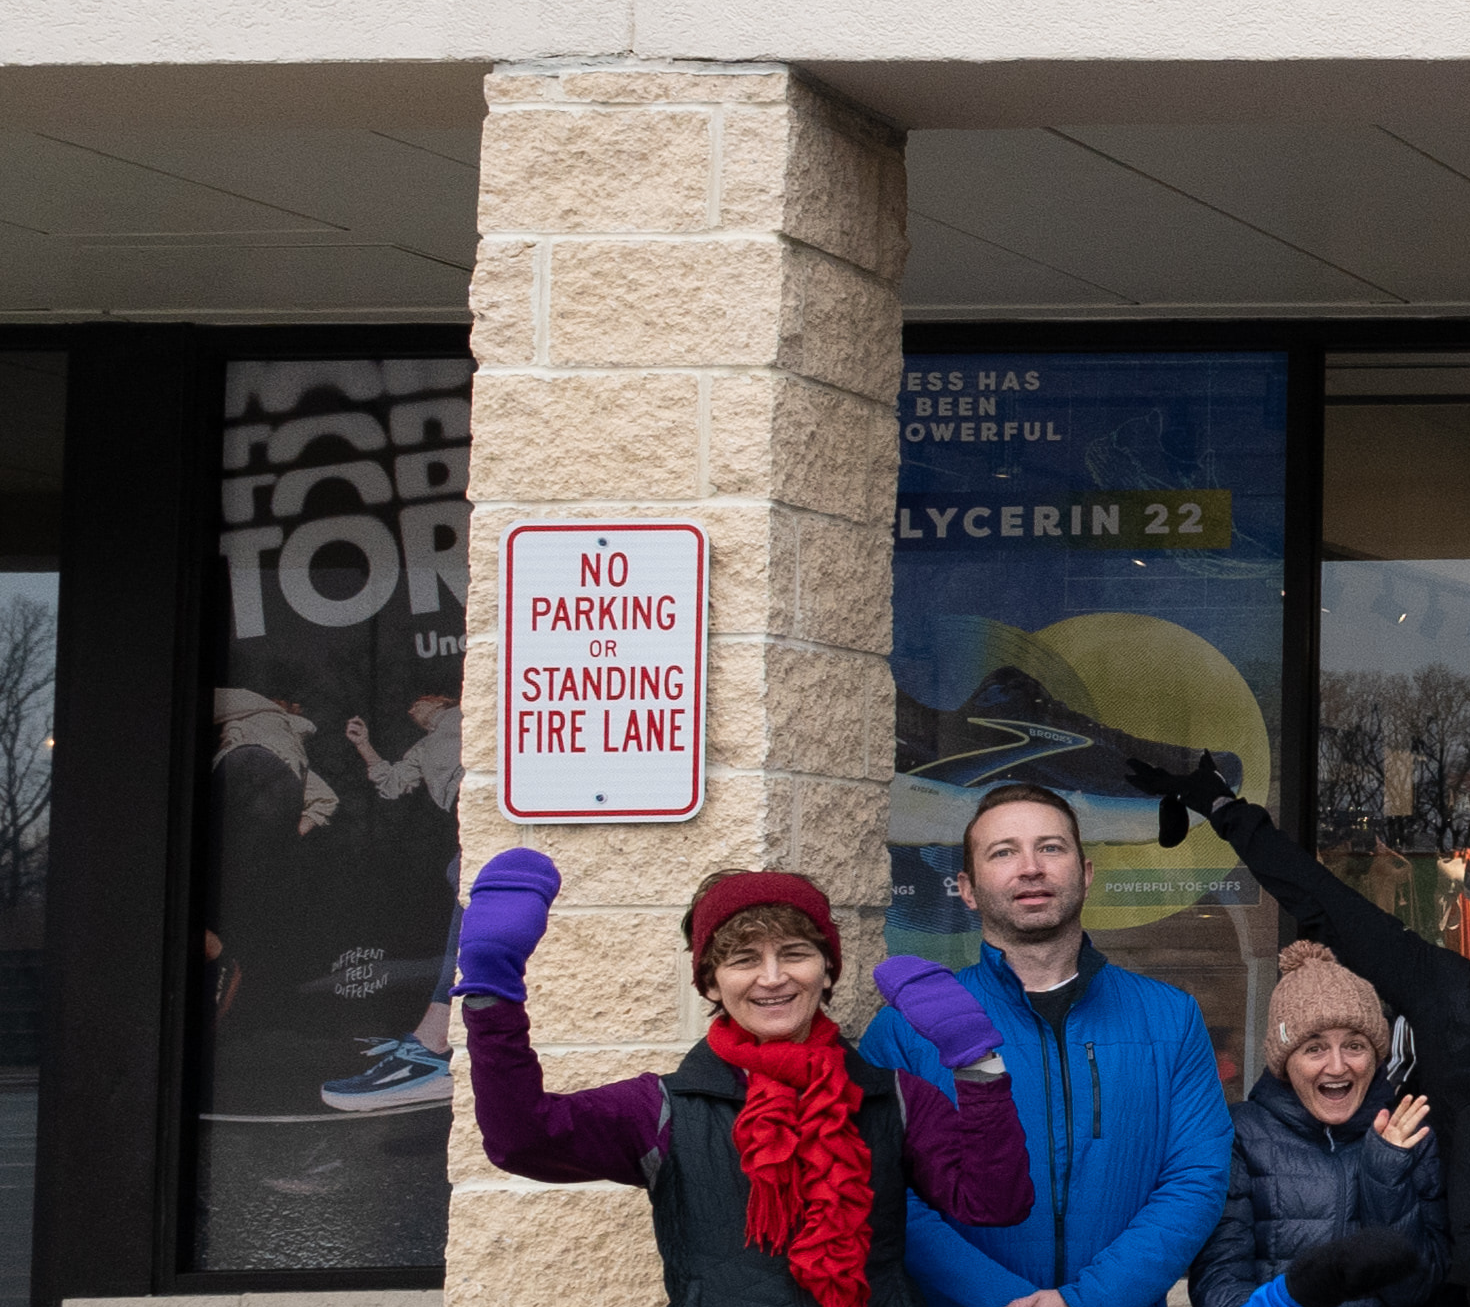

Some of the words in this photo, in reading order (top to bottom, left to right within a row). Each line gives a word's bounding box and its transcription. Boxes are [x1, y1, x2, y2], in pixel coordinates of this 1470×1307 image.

[978, 371, 1040, 390] HAS
[916, 397, 996, 416] BEEN
[1144, 503, 1203, 534] 22
[581, 552, 629, 587] NO
[532, 595, 676, 631] PARKING
[589, 640, 617, 658] OR
[522, 665, 684, 702] STANDING
[518, 710, 586, 753] FIRE
[604, 708, 686, 752] LANE
[1105, 881, 1174, 893] POWERFUL
[1178, 881, 1241, 892] TOE-OFFS
